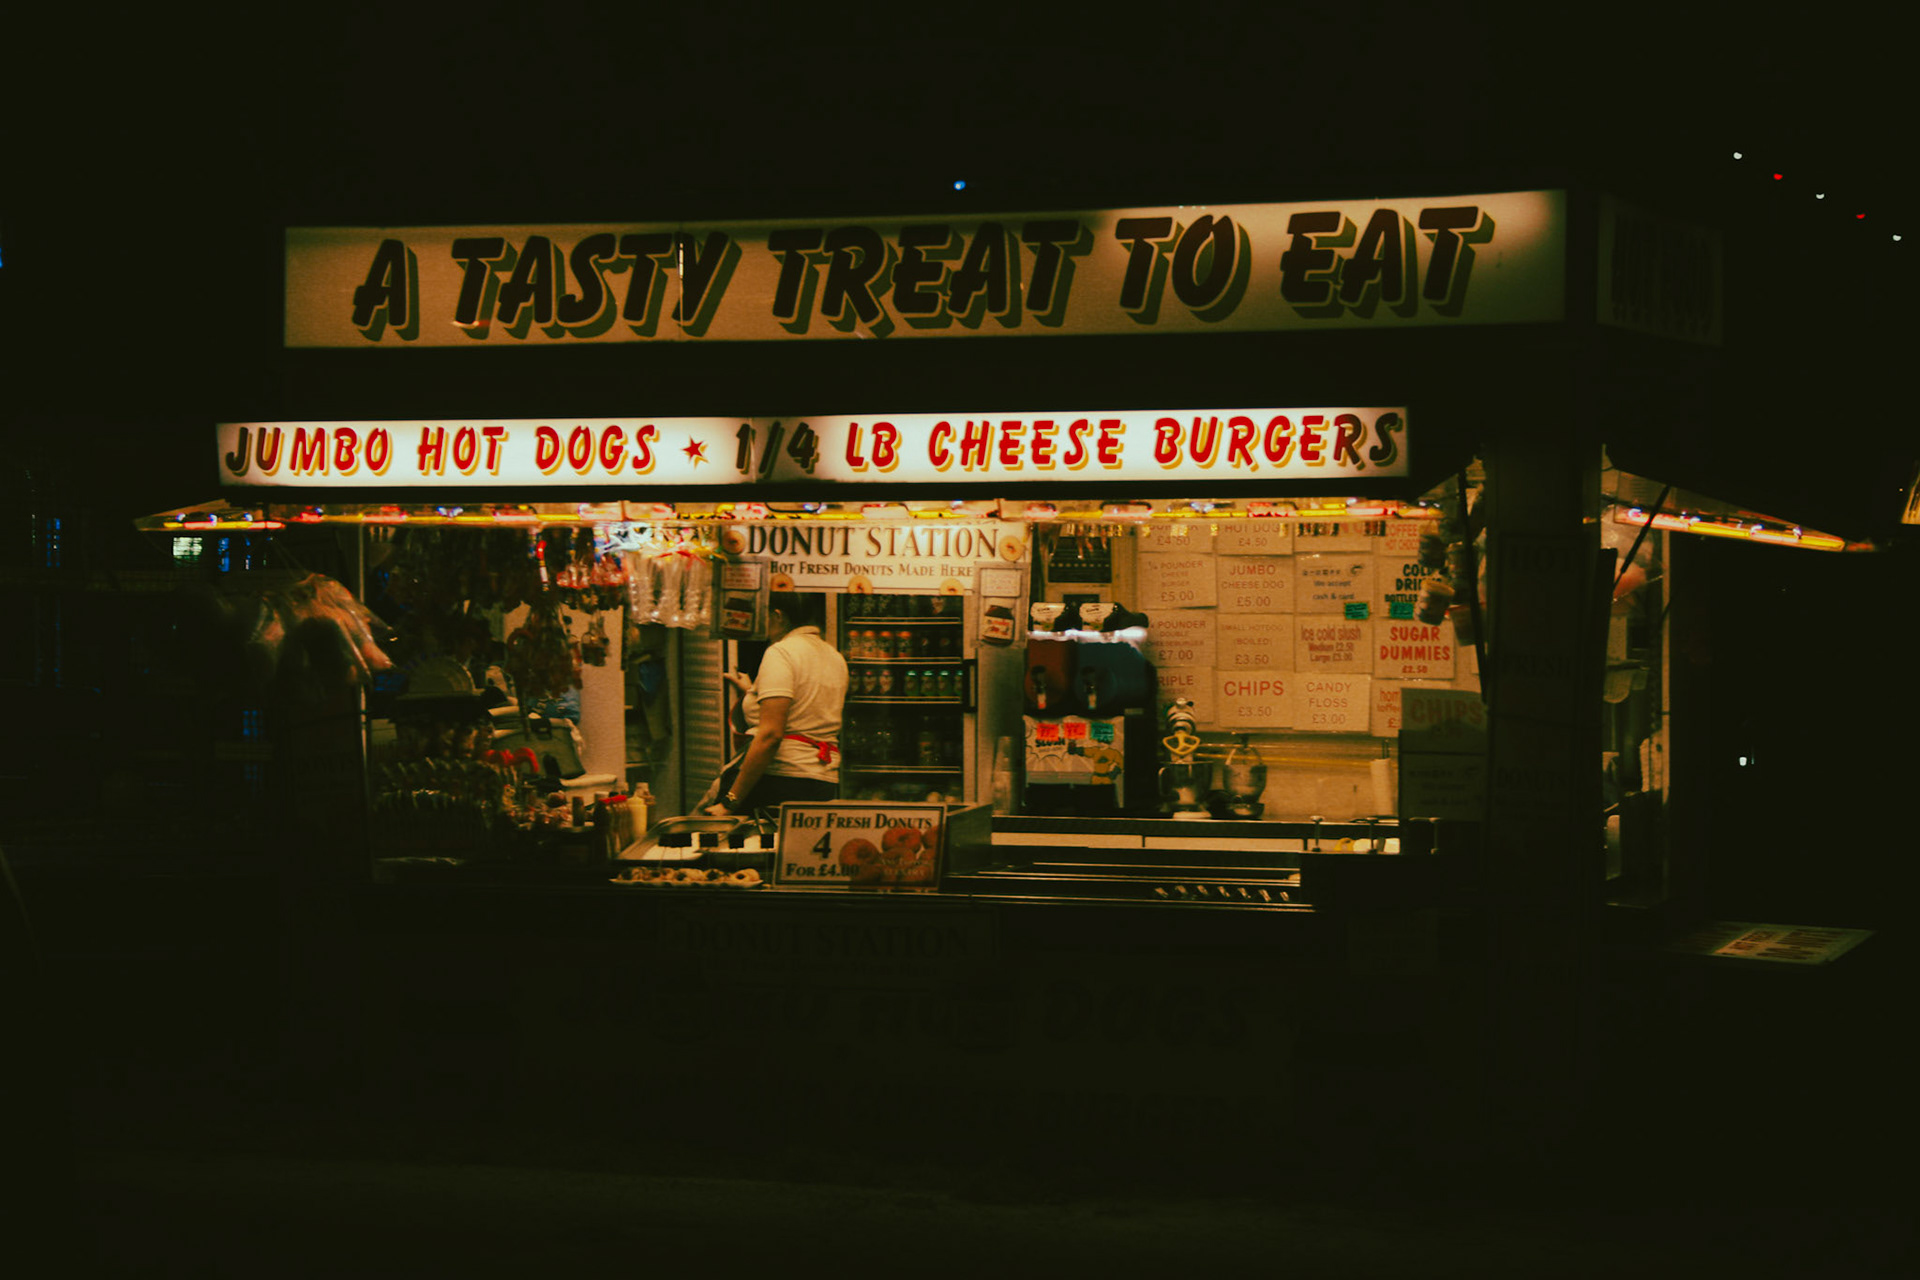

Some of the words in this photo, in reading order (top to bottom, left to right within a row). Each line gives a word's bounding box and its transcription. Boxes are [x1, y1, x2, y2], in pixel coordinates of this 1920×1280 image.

[351, 238, 420, 341] A
[451, 231, 743, 340] TASTY
[767, 216, 1096, 340] TREAT
[1115, 213, 1253, 326] TO
[1280, 206, 1496, 322] EAT
[225, 425, 394, 479] JUMBO
[417, 425, 510, 478] HOT
[535, 423, 662, 477] DOGS
[734, 421, 820, 478] 1/4
[845, 420, 903, 474] LB
[928, 417, 1127, 474] CHEESE
[1153, 410, 1403, 472] BURGERS
[748, 526, 856, 558] DONUT
[865, 526, 997, 559] STATION
[1229, 563, 1276, 576] JUMBO
[1221, 580, 1259, 590] CHEESE
[1262, 580, 1285, 589] DOG
[1236, 596, 1271, 607] £5.00
[1157, 620, 1206, 629] POUNDER
[1389, 626, 1441, 641] SUGAR
[1158, 650, 1194, 660] £7.00
[1380, 646, 1451, 661] DUMMIES
[1224, 680, 1284, 697] CHIPS
[1306, 681, 1352, 693] CANDY
[1309, 698, 1348, 709] FLOSS
[791, 812, 822, 830] HOT
[826, 812, 872, 829] FRESH
[875, 813, 934, 830] DONUTS
[812, 831, 832, 860] 4
[786, 863, 816, 877] FOR
